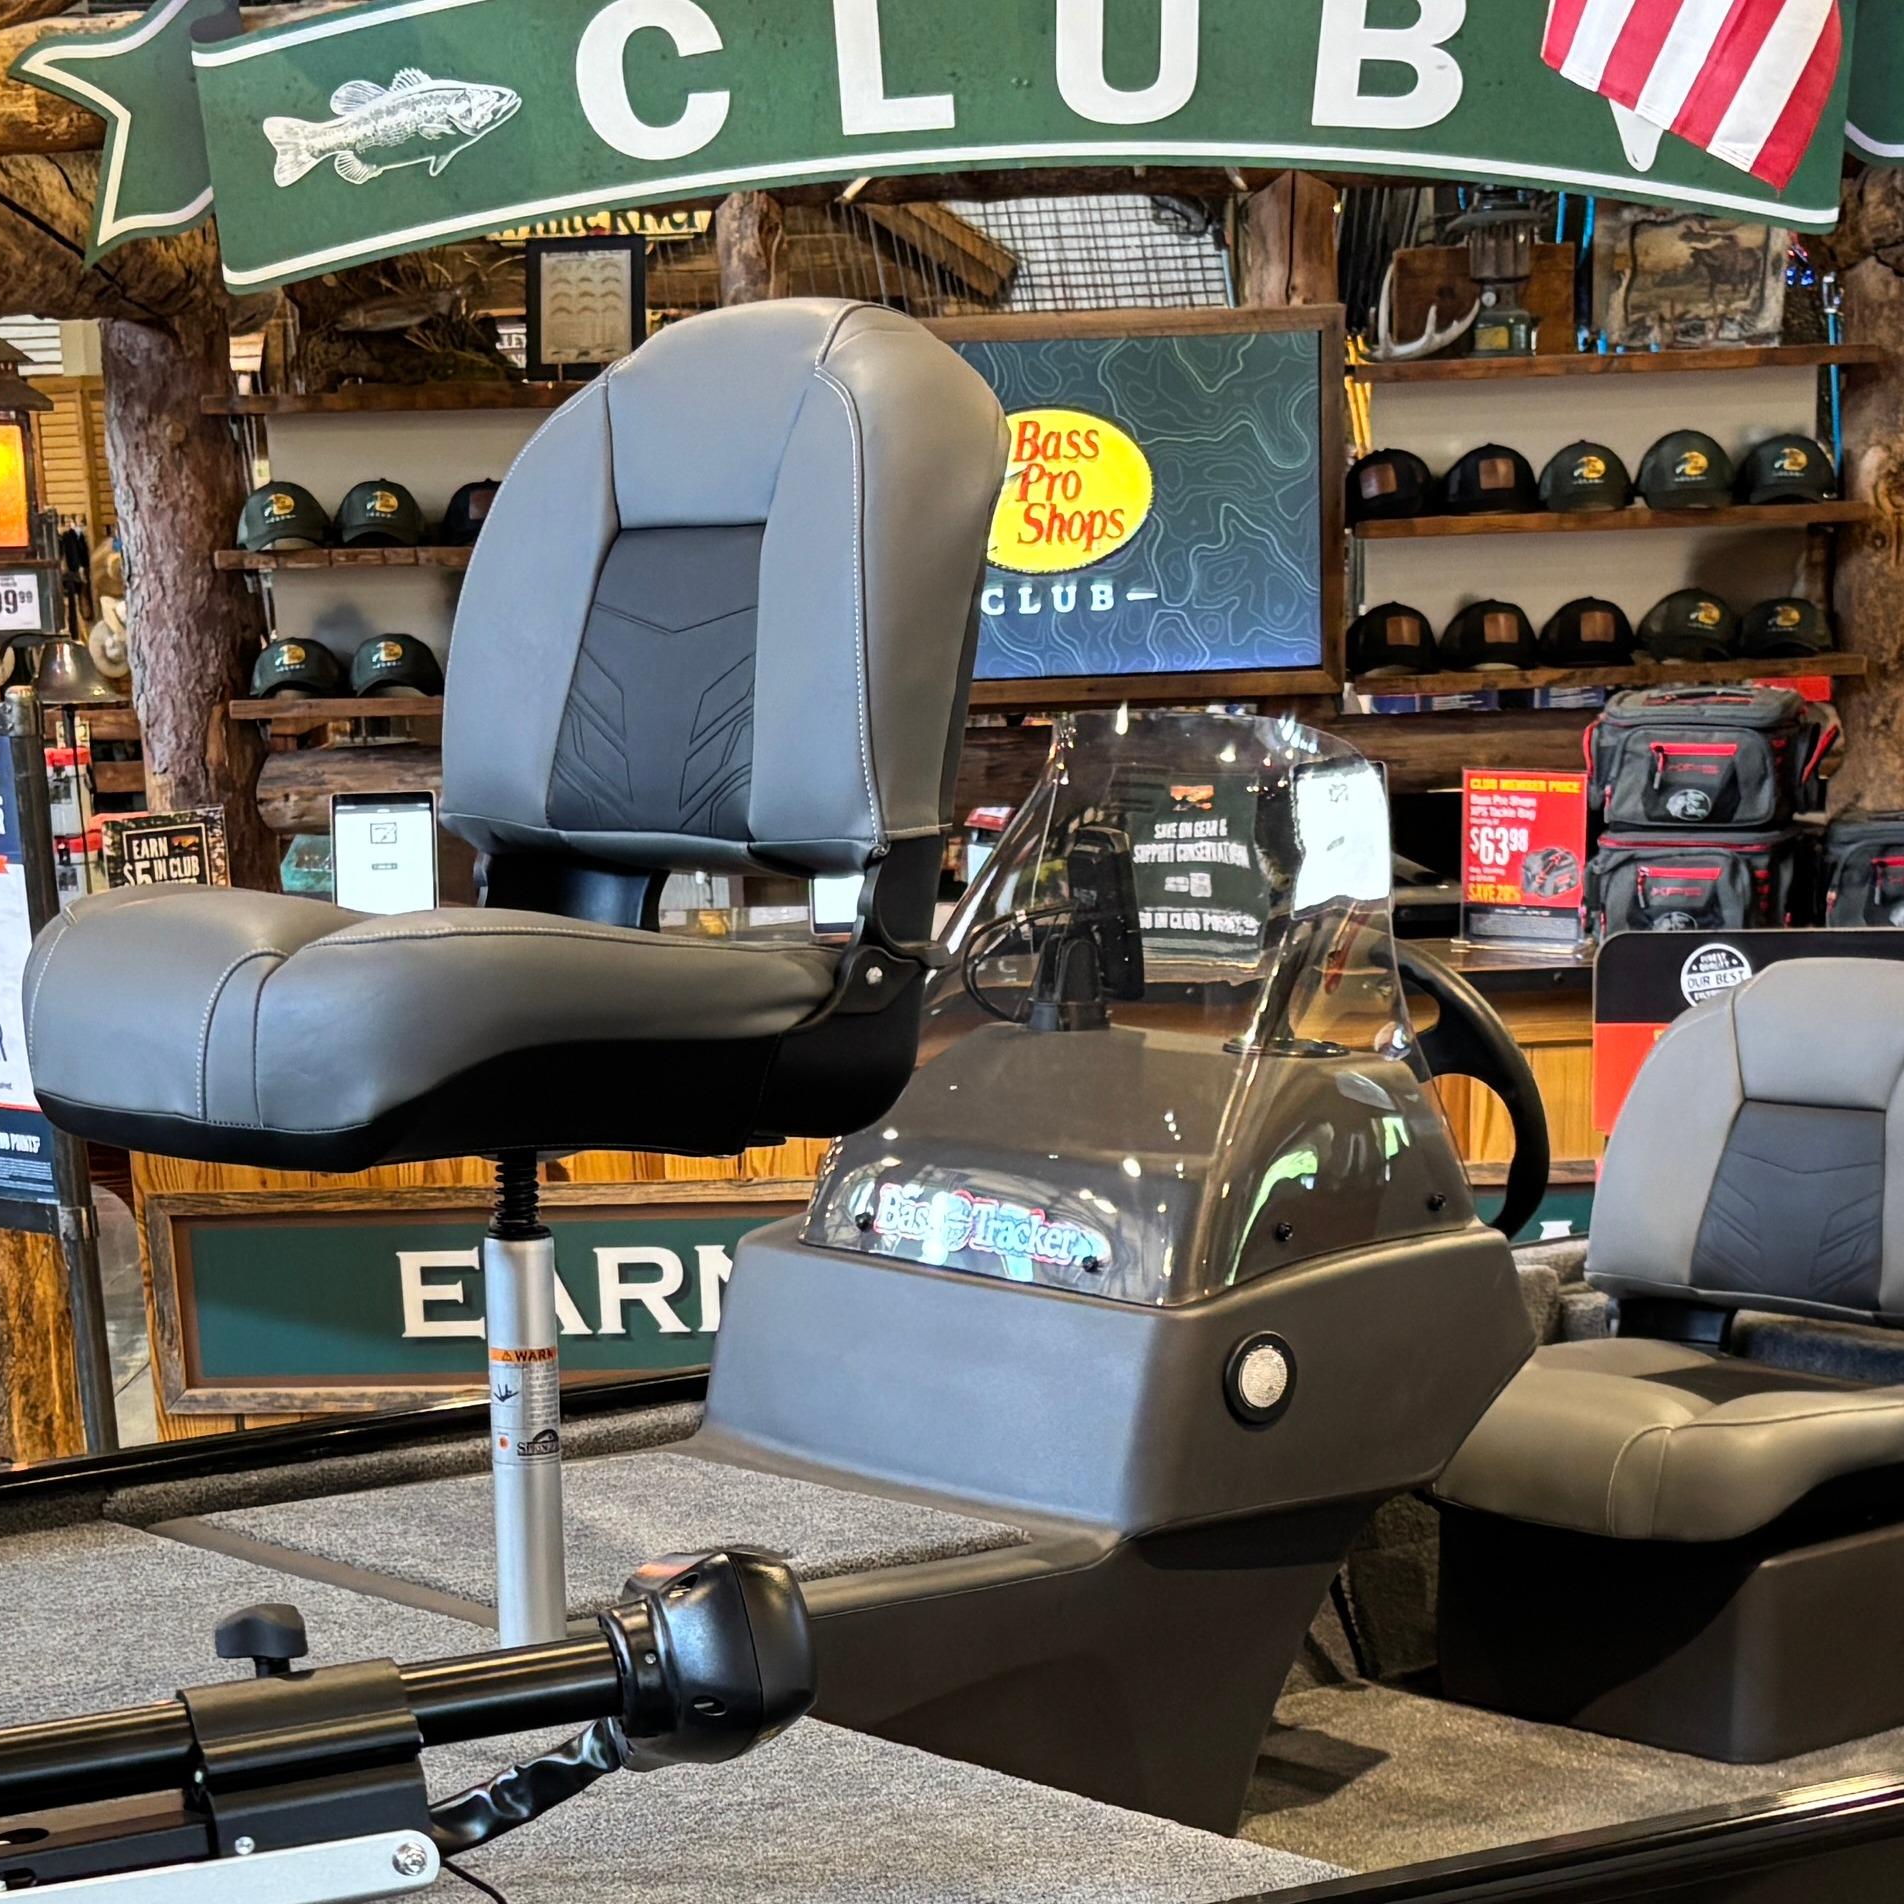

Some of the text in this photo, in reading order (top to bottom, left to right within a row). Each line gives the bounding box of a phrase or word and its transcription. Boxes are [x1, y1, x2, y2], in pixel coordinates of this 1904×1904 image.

[576, 0, 1464, 160] CLUB
[1012, 420, 1100, 463] Bass
[1014, 463, 1082, 502] Pro
[1017, 502, 1125, 552] Shops
[980, 584, 1115, 616] CLUB
[1154, 822, 1178, 839] SAVE
[132, 836, 169, 860] EARN
[1133, 842, 1175, 864] SUPPORT
[123, 855, 200, 886] $5 IN CLUB
[1468, 883, 1497, 902] SAVE
[1687, 970, 1745, 989] OUR BEST
[972, 1204, 1084, 1262] Tracker
